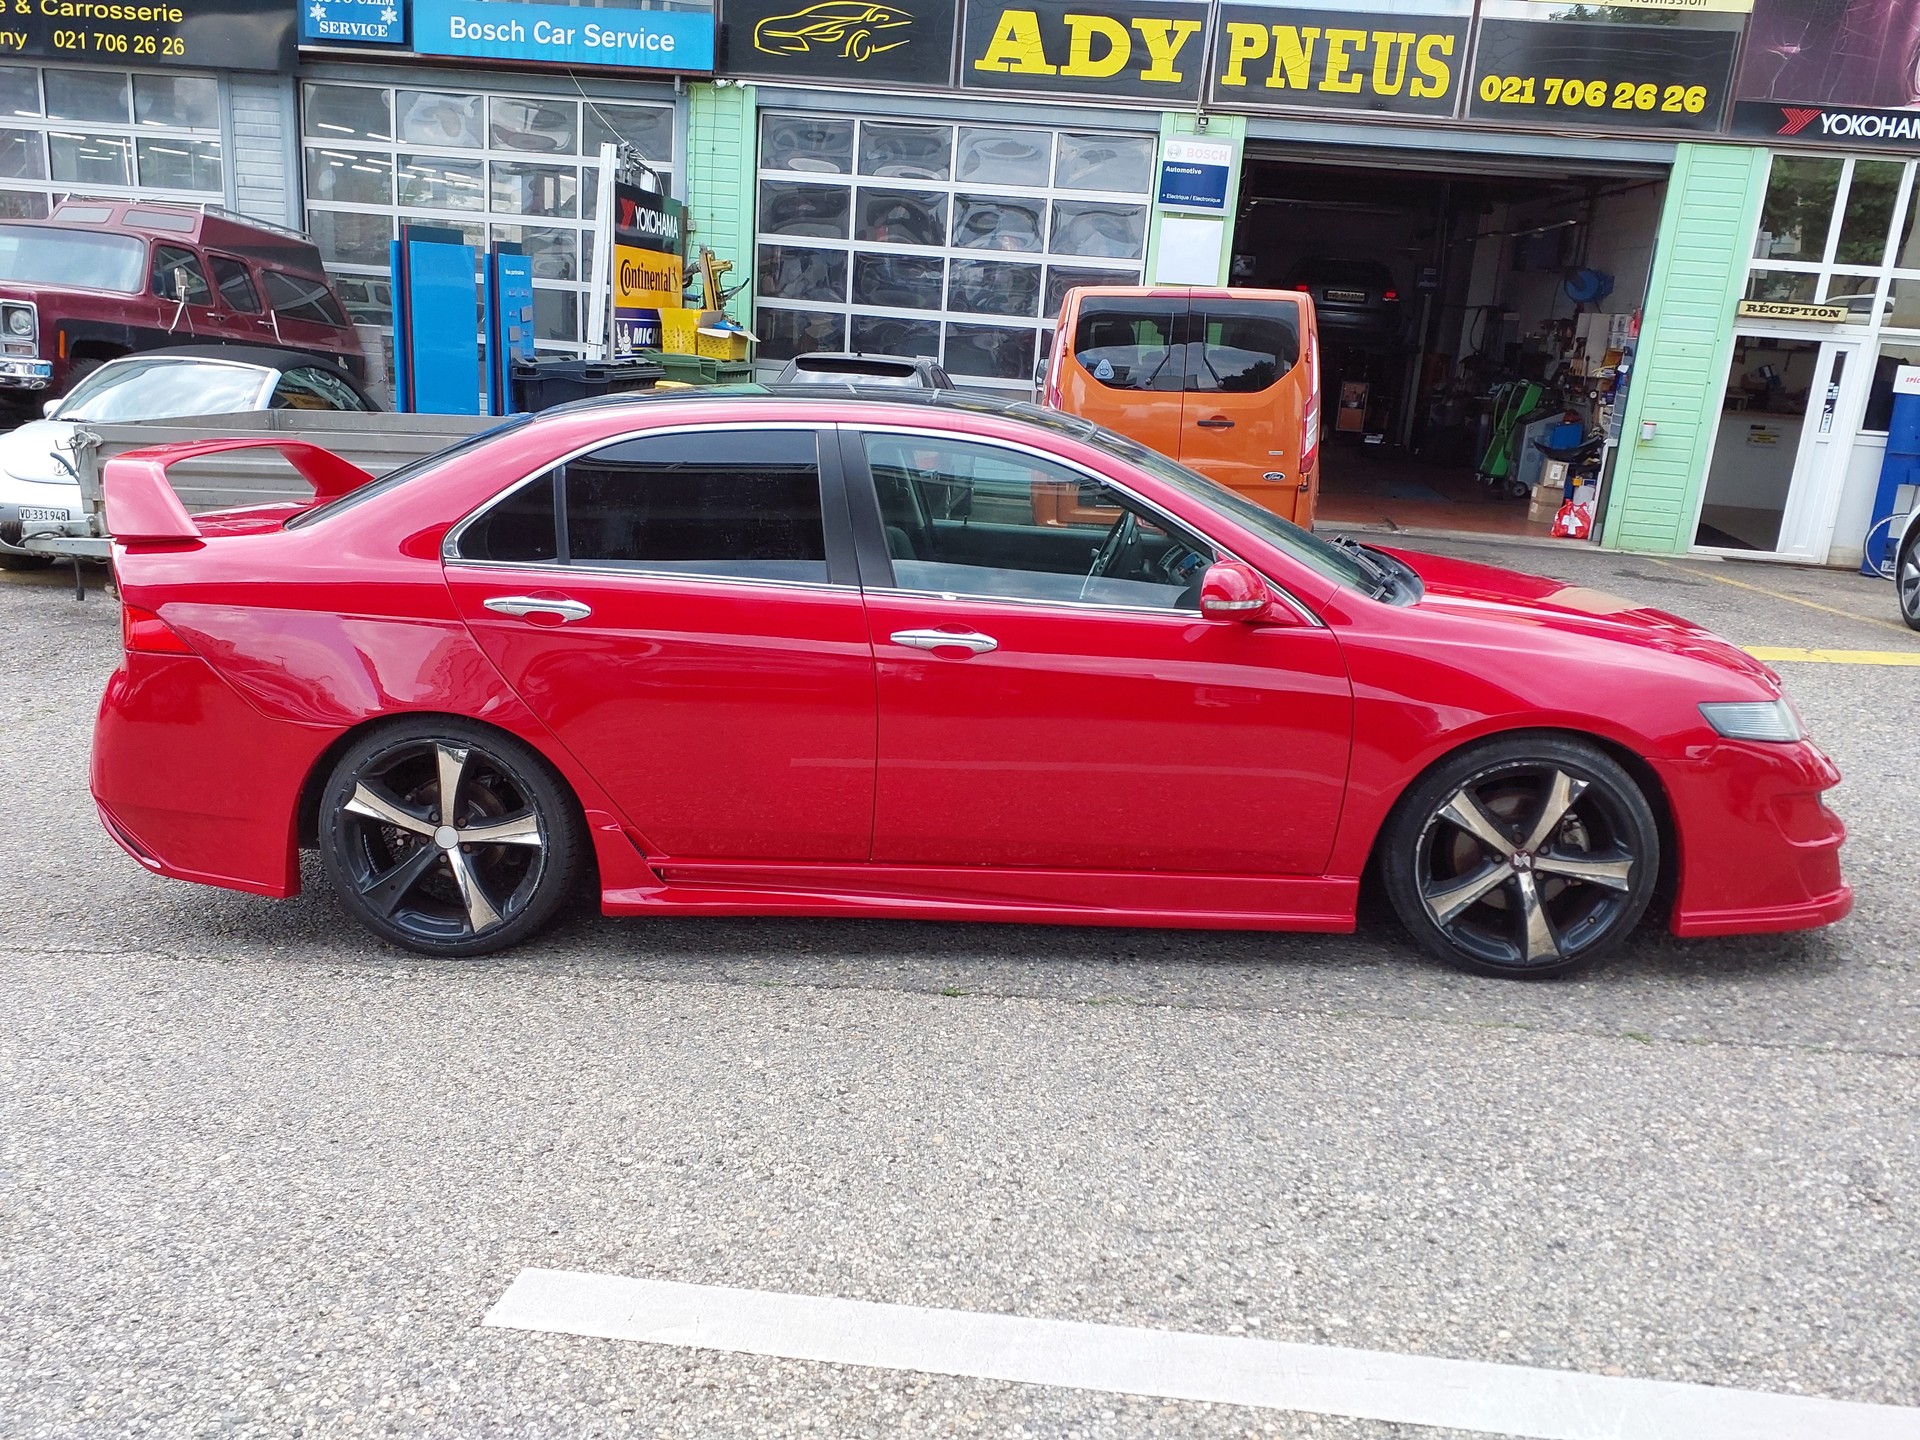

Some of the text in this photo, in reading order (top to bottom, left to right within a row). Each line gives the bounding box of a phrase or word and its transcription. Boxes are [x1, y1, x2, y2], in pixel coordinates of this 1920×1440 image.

[40, 0, 183, 22] Carrosserie
[319, 20, 388, 37] SERVICE
[450, 16, 675, 52] Bosch Car Service
[53, 30, 87, 50] 021
[93, 33, 128, 53] 706
[133, 35, 157, 54] 26
[162, 37, 185, 56] 26
[974, 9, 1455, 99] ADY PNEUS
[1480, 75, 1707, 114] 021 706 26 26
[1187, 148, 1227, 161] BOSCH
[1165, 166, 1202, 175] Automotive
[634, 205, 679, 239] YOKOHAMA
[620, 259, 672, 297] Continental
[1745, 302, 1841, 318] RÉCEPTION
